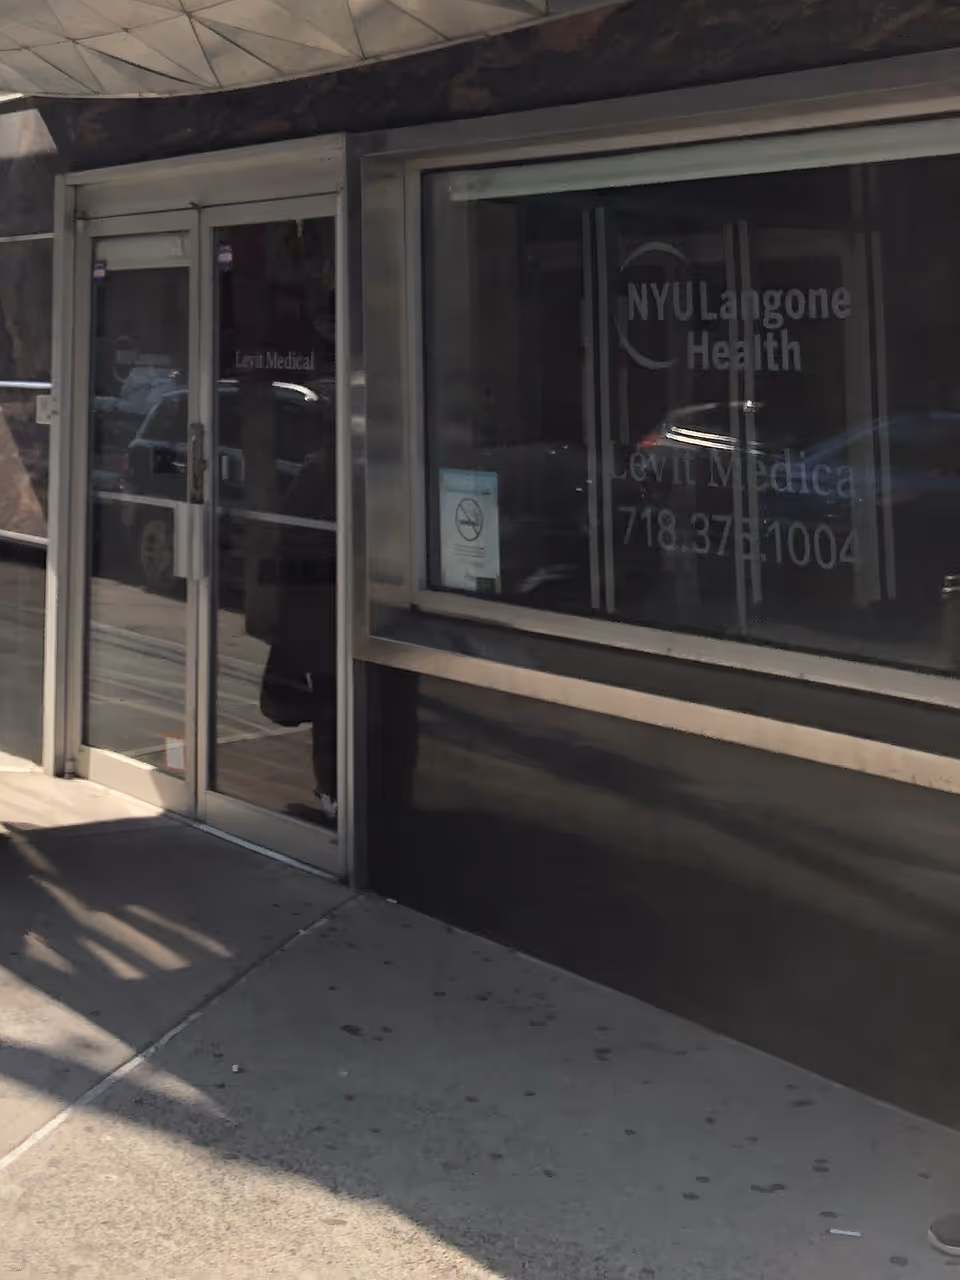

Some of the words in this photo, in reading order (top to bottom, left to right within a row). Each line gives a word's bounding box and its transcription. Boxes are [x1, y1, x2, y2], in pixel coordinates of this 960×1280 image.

[266, 350, 314, 370] Medical
[687, 329, 801, 371] Health
[707, 447, 861, 499] Medica
